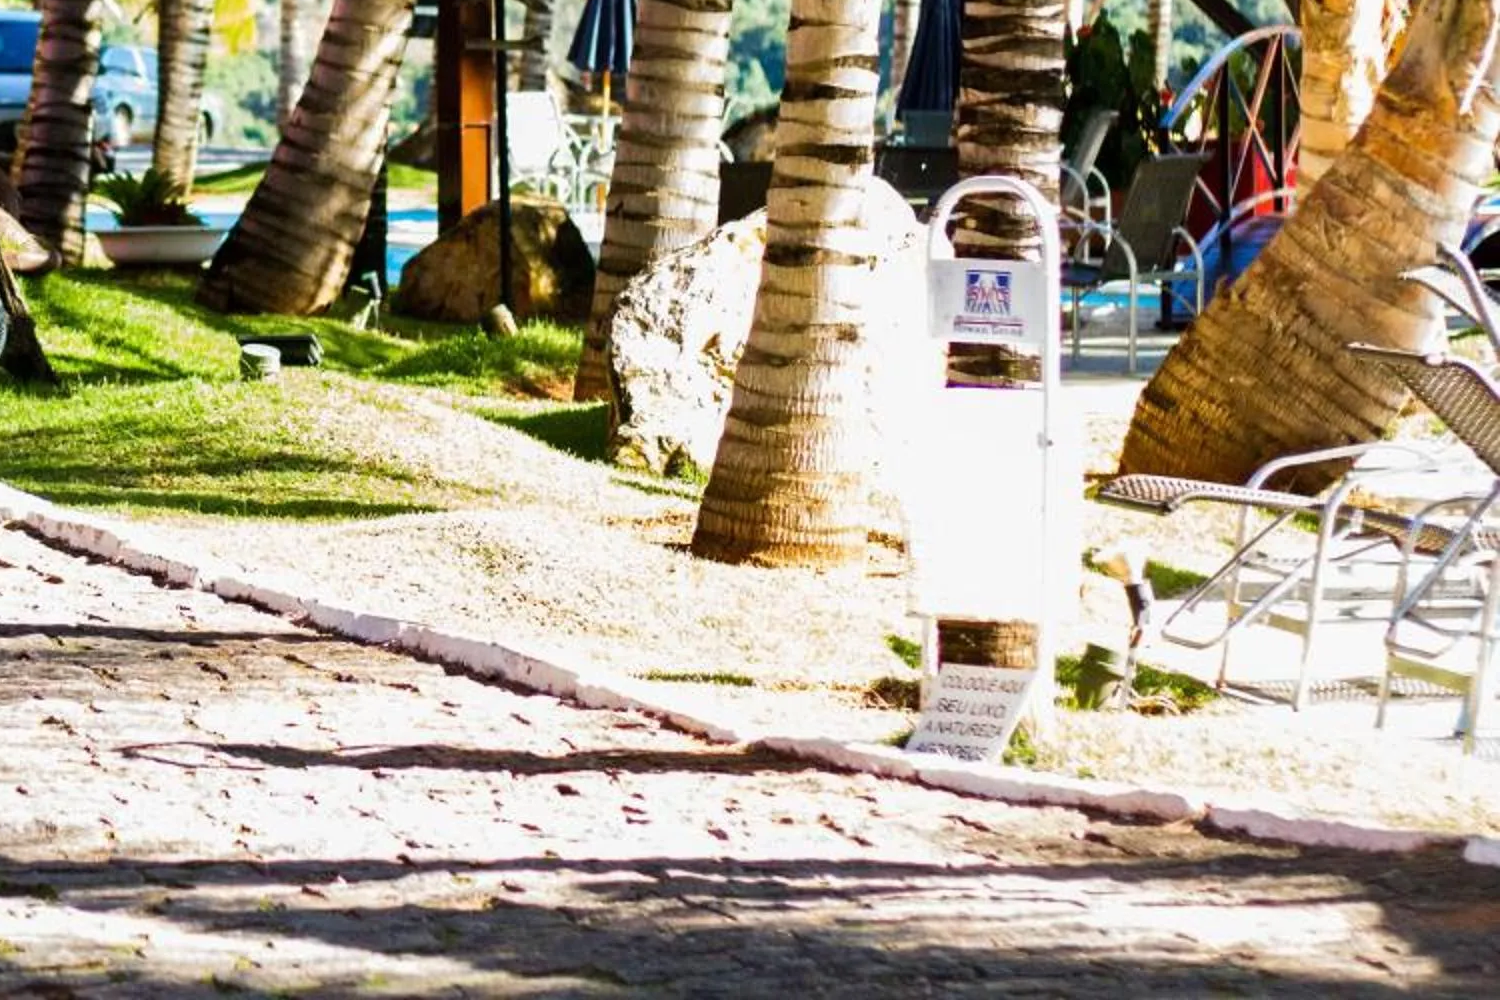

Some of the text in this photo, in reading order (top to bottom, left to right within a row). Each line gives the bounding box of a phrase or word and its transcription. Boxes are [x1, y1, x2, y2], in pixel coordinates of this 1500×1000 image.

[941, 674, 998, 692] COLOQUE
[937, 697, 1007, 719] SEU LIXO
[923, 719, 1003, 739] A NATUREZA
